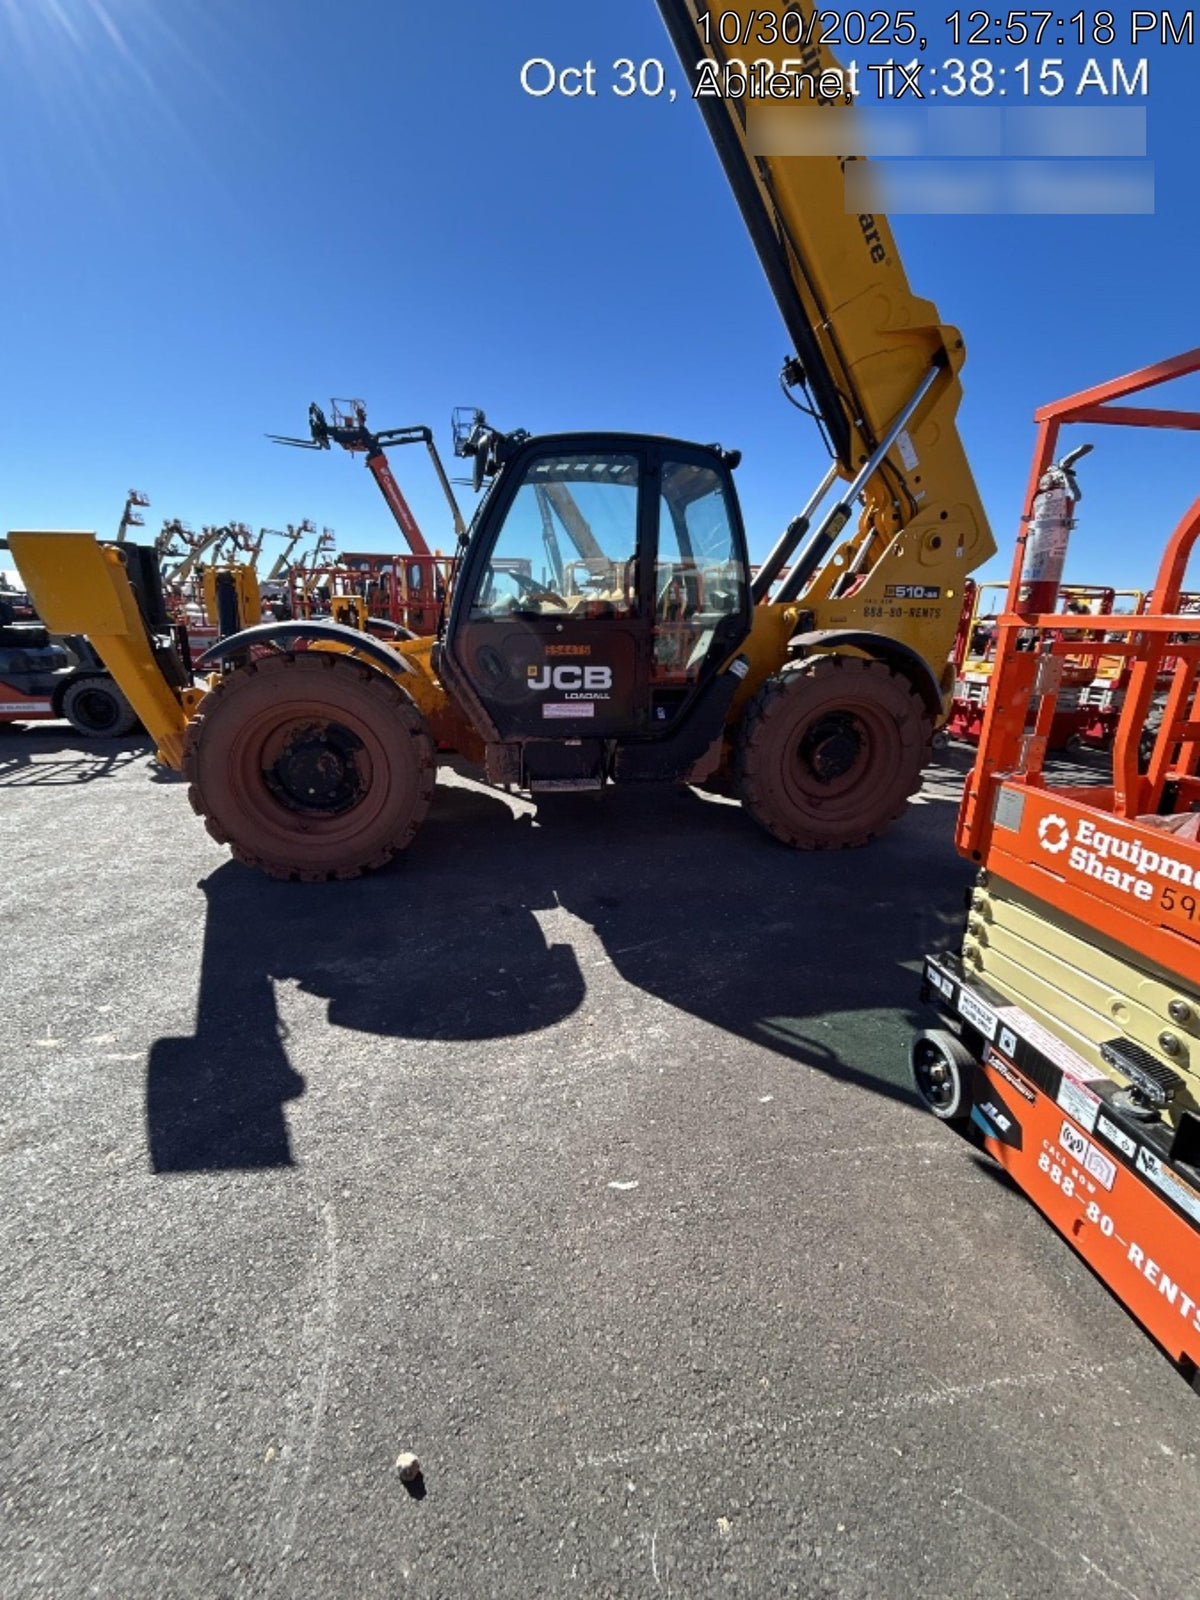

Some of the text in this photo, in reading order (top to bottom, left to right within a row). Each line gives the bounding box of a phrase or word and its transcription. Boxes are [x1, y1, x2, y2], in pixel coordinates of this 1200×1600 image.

[527, 665, 612, 690] JCB
[1068, 845, 1154, 901] Share
[1160, 886, 1200, 920] 59
[1042, 1138, 1097, 1195] CALL NOW
